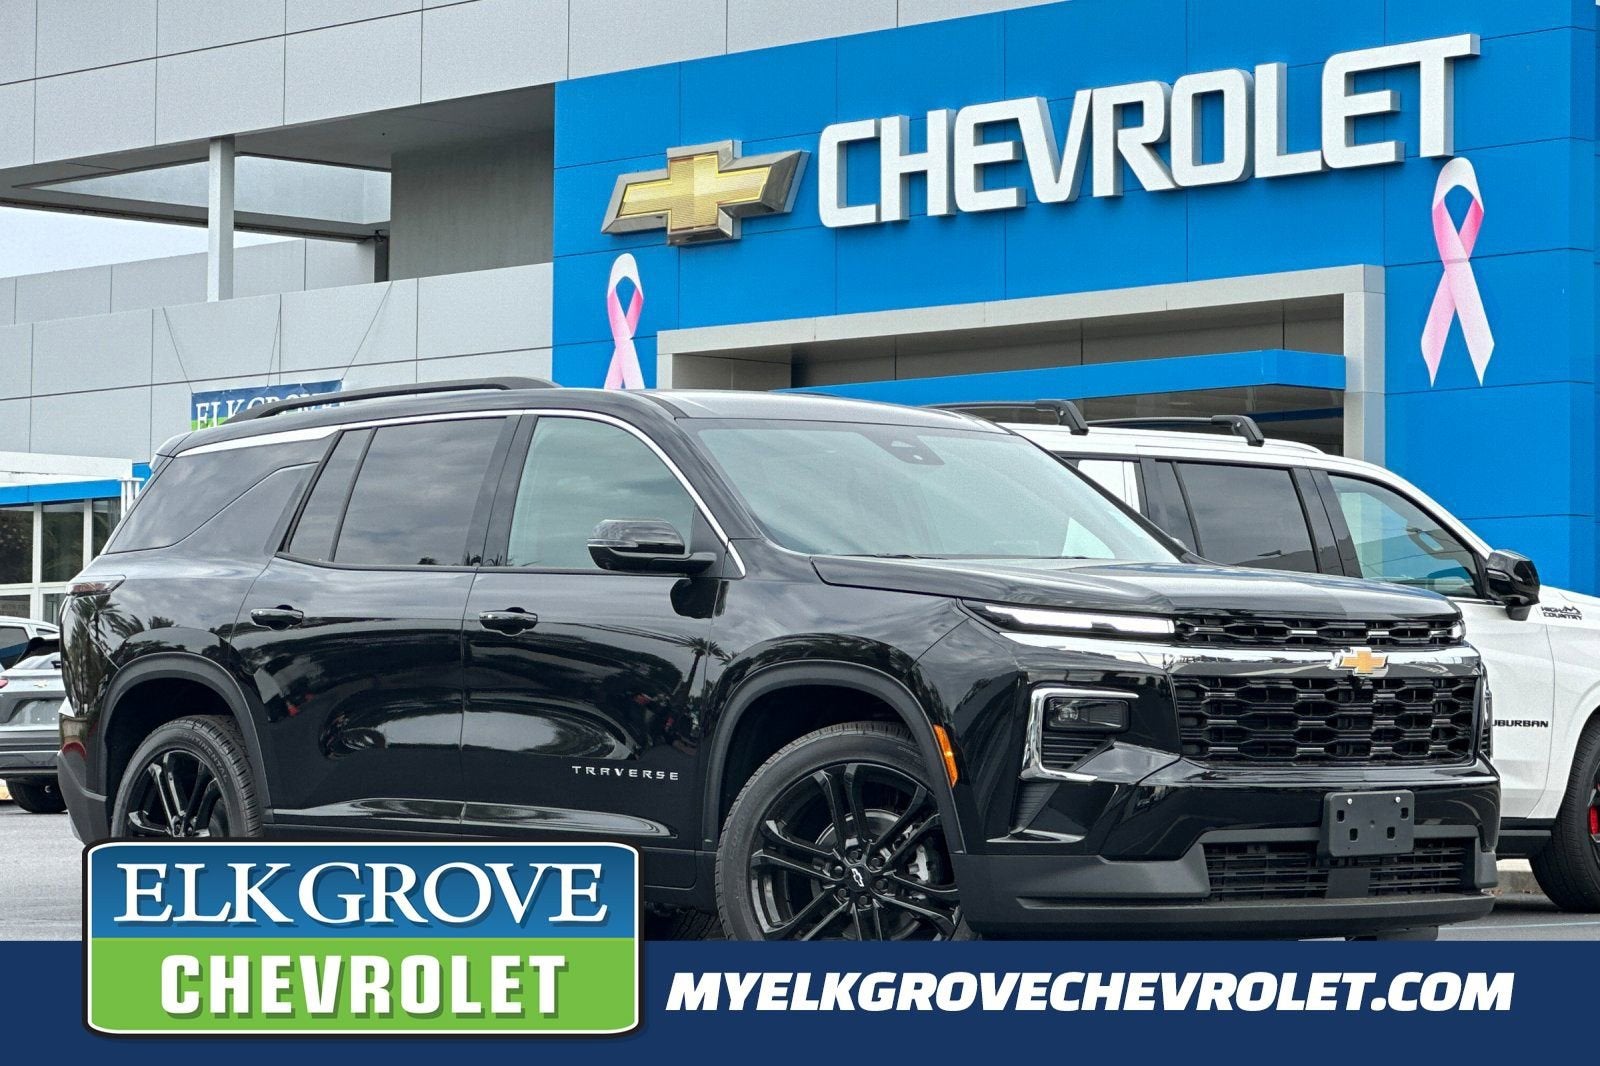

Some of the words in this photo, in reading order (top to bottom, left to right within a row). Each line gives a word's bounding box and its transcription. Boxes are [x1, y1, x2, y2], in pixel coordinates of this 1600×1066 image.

[818, 33, 1480, 228] CHEVROLET
[1541, 606, 1563, 614] HIGH
[1543, 612, 1582, 620] COUNTRY
[1492, 719, 1549, 728] UBURBAN
[571, 765, 679, 781] TRAVERSE
